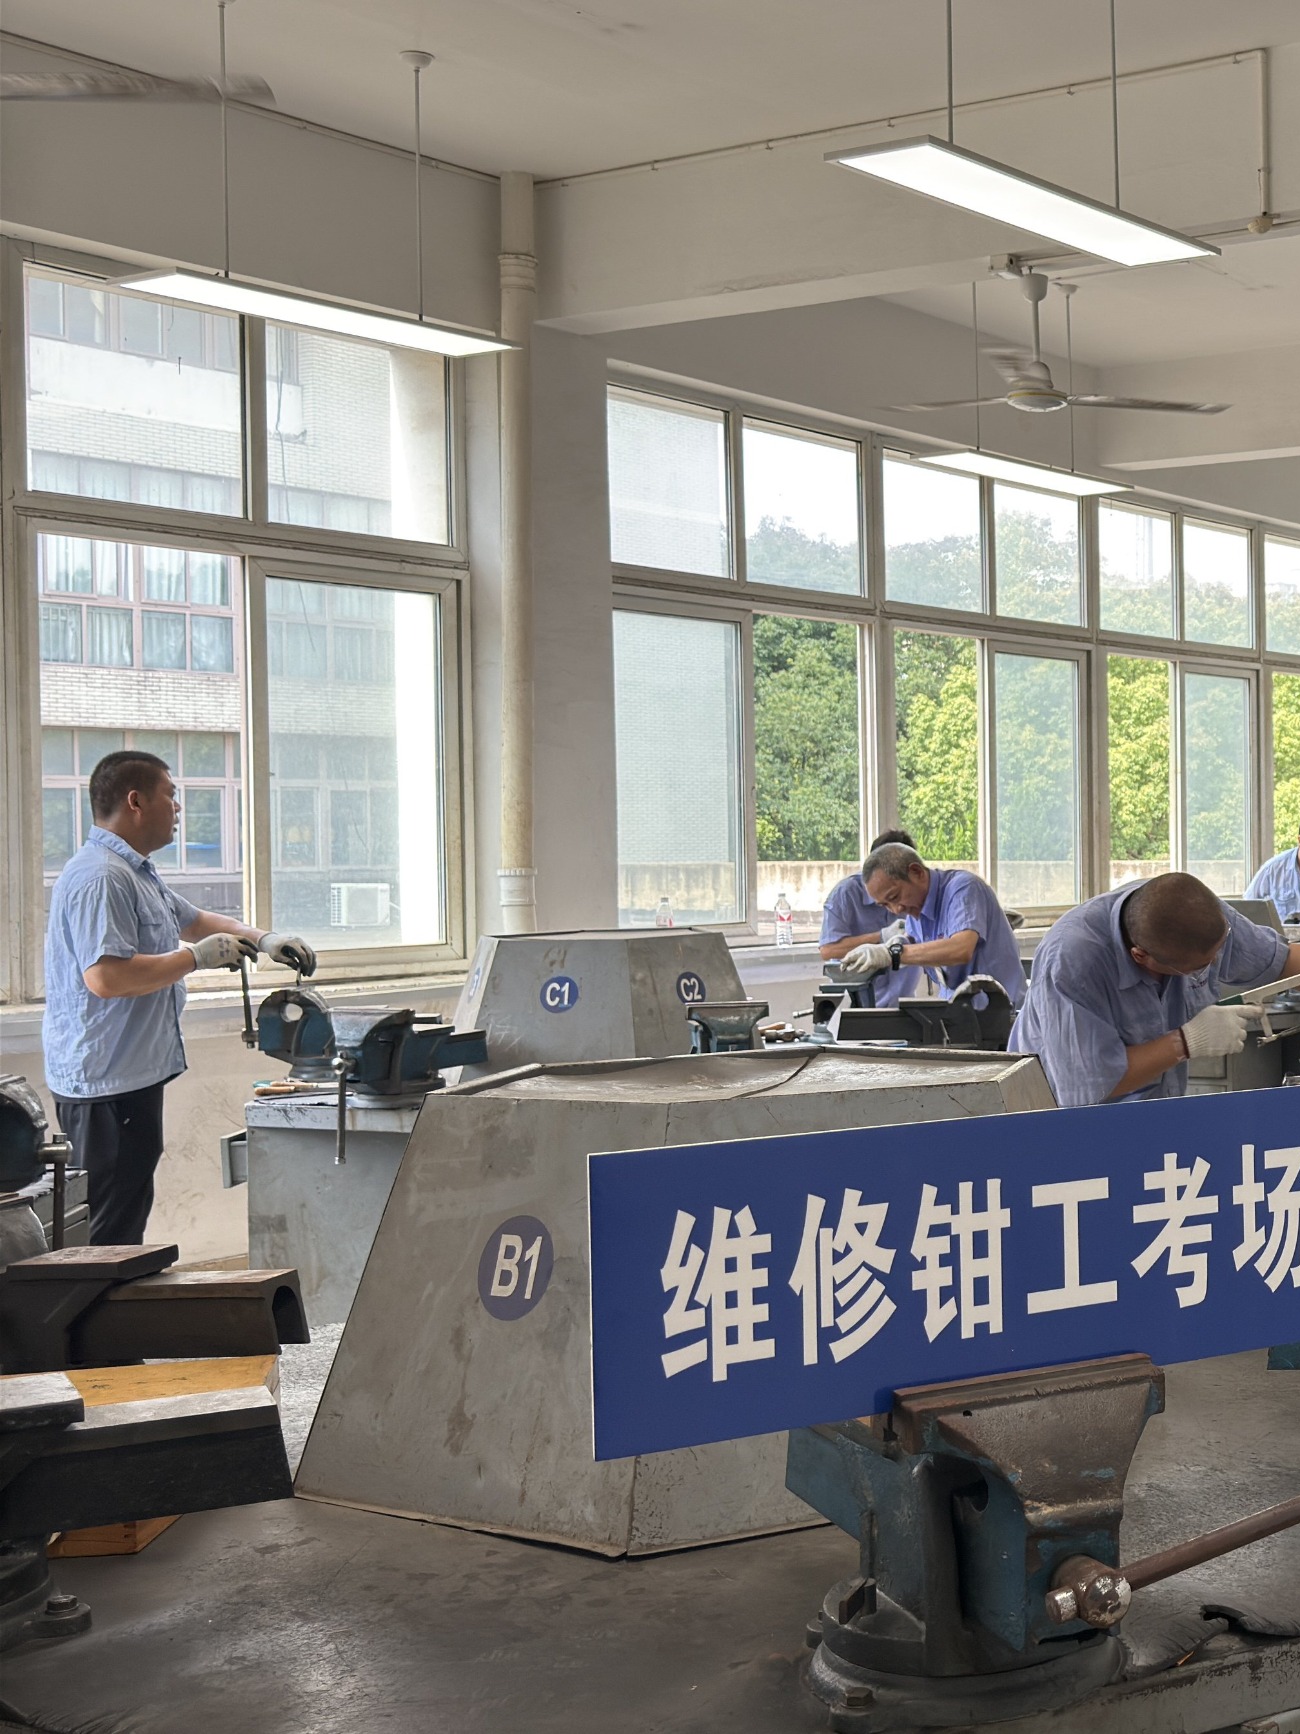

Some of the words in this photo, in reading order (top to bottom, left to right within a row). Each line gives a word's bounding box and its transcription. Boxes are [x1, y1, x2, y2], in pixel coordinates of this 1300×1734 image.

[546, 982, 570, 1006] C1
[680, 977, 703, 1001] C2
[490, 1233, 543, 1299] B1
